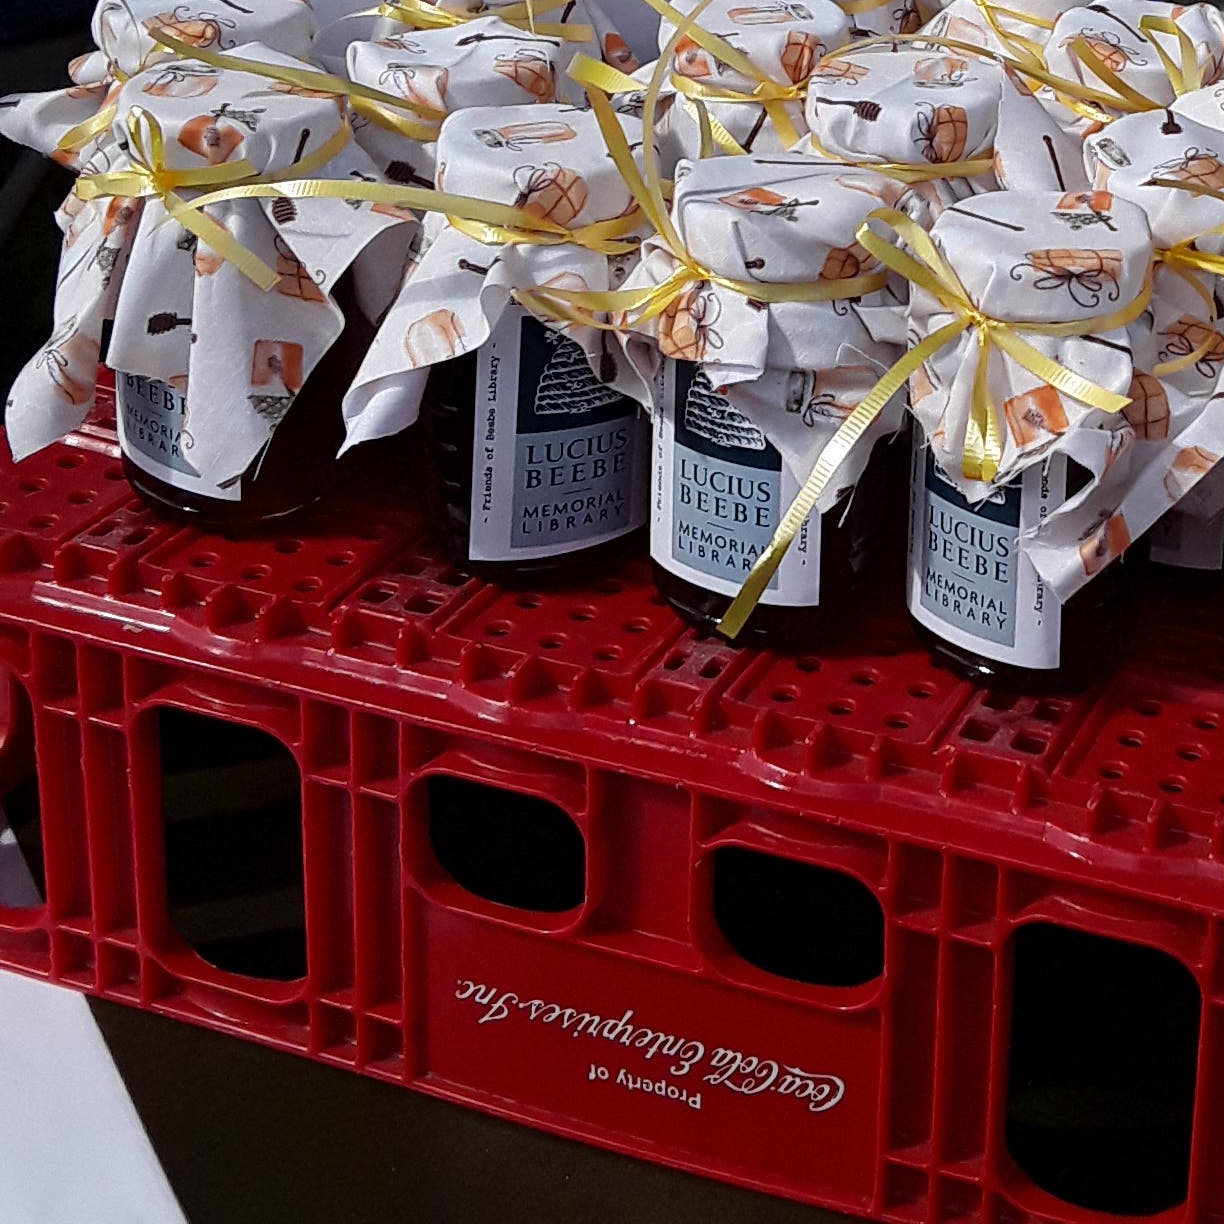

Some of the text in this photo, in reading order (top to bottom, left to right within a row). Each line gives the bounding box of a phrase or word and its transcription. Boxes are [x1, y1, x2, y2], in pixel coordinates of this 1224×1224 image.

[488, 354, 502, 403] Library
[486, 445, 495, 461] of
[526, 428, 628, 466] LUCIUS
[525, 452, 626, 489] BEEBE
[680, 458, 771, 503] LUCIUS
[522, 489, 626, 520] MEMORIAL
[522, 505, 625, 534] LIBRARY
[680, 482, 770, 528] BEEBE
[928, 504, 1010, 558] LUCIUS
[678, 536, 753, 572] LIBRAR
[927, 530, 1010, 584] BEEBE
[925, 582, 1007, 631] LIBRARY
[926, 566, 1008, 616] MEMORIAL
[518, 998, 705, 1076] Enterprises
[588, 1064, 702, 1109] Property of
